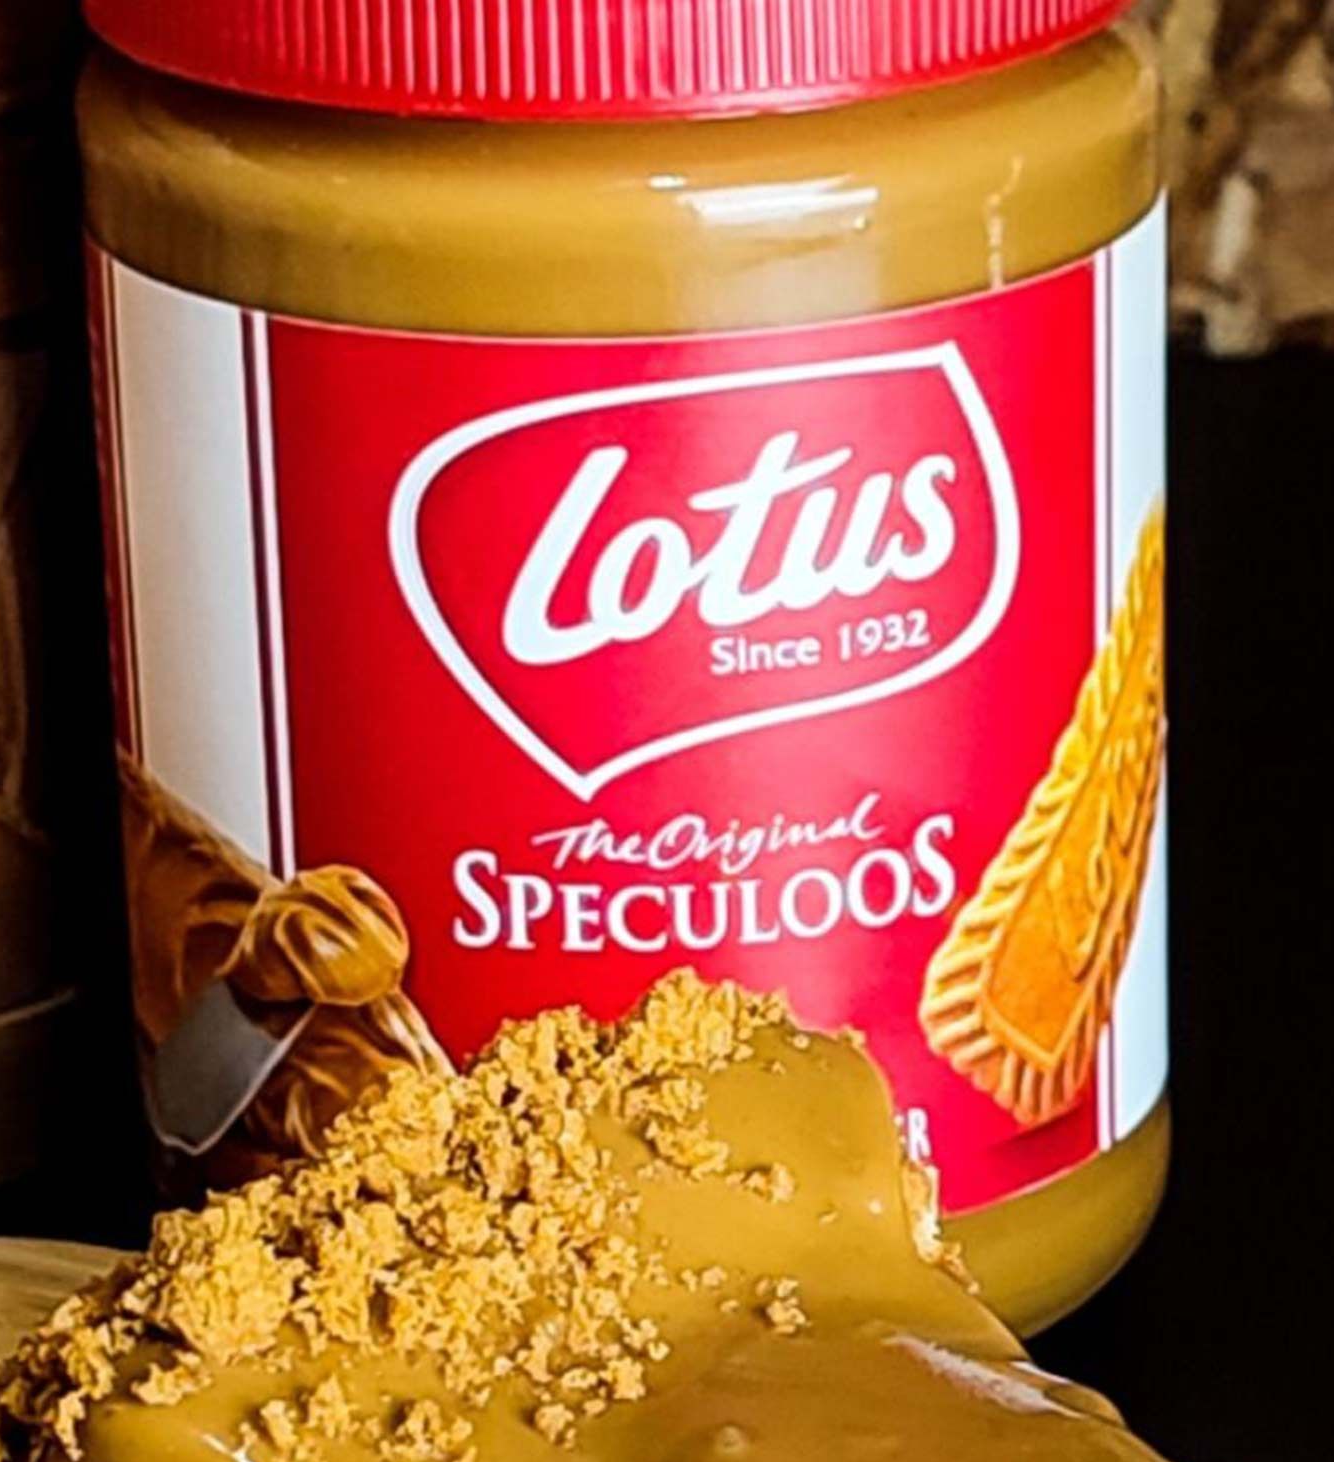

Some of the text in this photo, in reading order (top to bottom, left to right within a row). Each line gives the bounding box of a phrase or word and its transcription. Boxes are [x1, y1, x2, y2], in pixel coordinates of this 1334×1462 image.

[503, 431, 955, 664] Lotus
[711, 609, 929, 674] Since 1932
[453, 815, 955, 952] SPECULOOS
[531, 793, 884, 874] The Original
